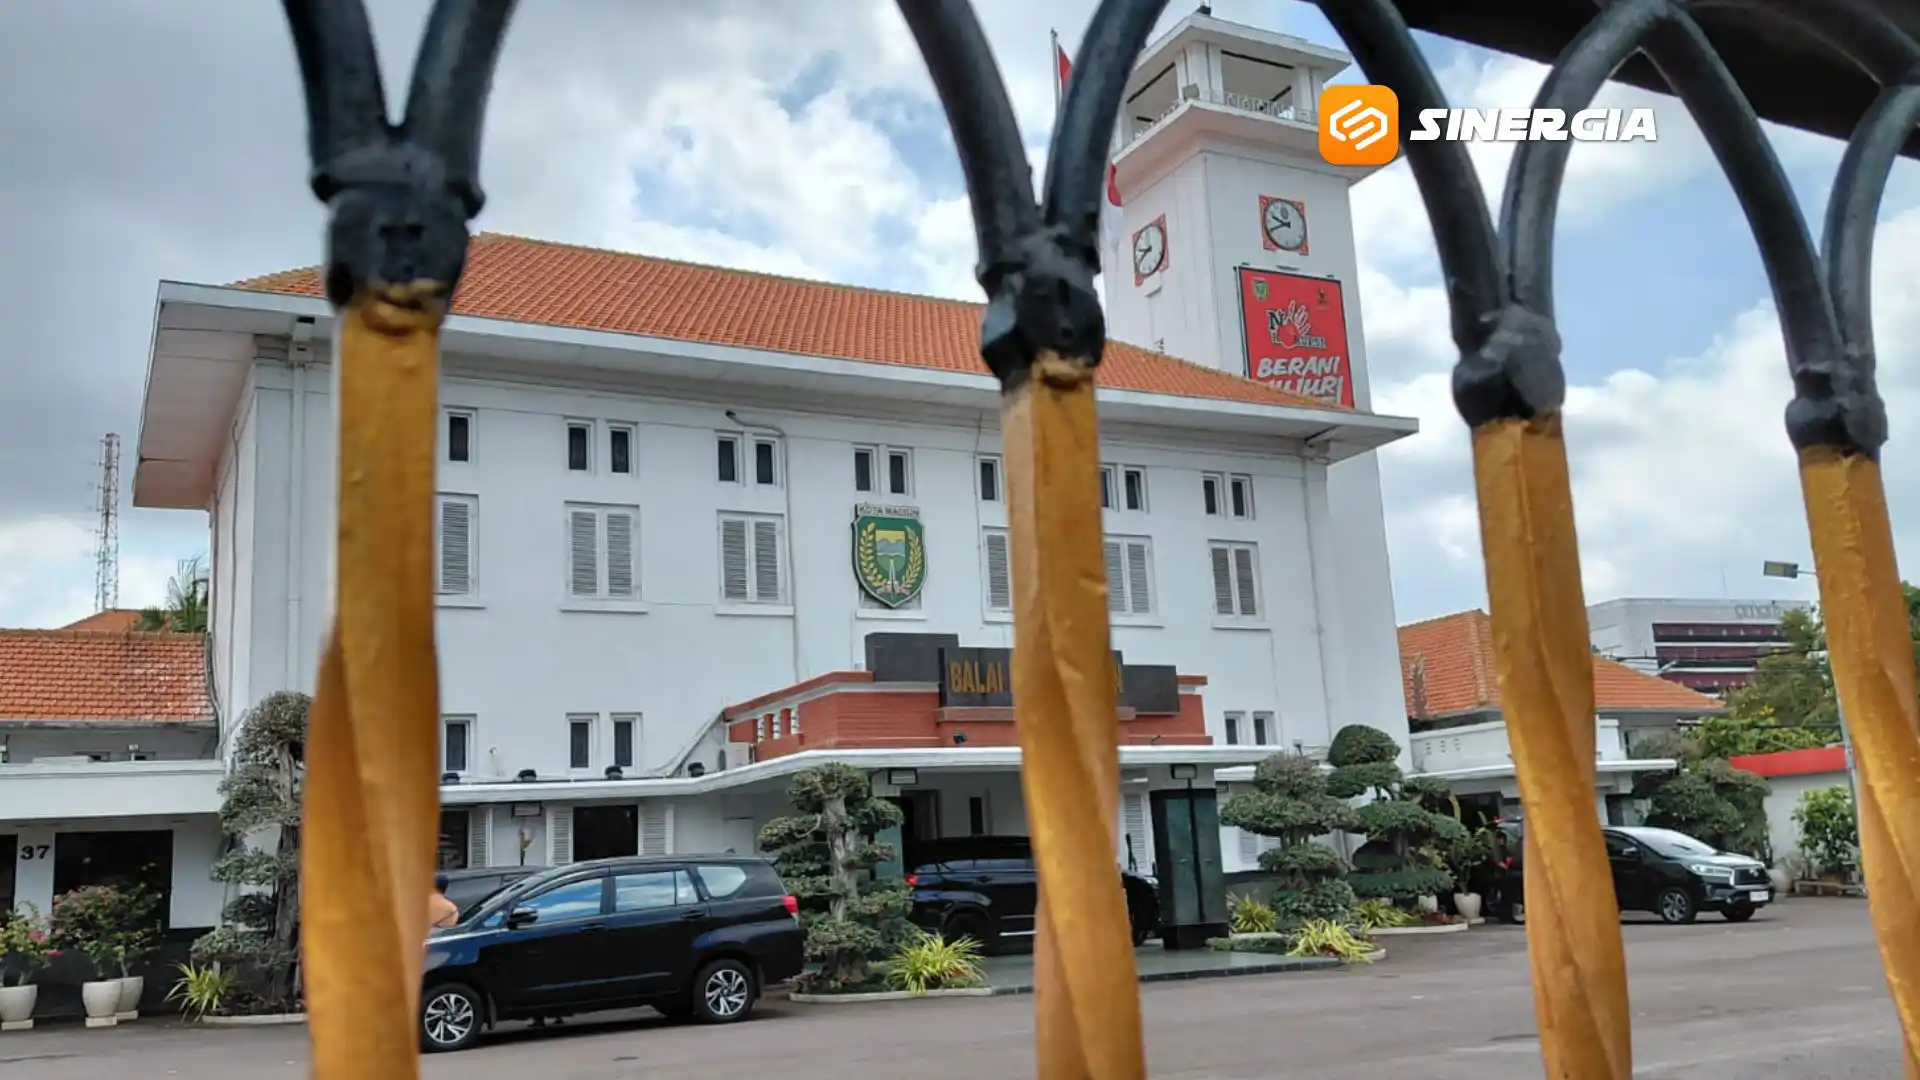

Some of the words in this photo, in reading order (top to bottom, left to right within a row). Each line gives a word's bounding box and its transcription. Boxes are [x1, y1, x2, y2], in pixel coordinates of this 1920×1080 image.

[1257, 356, 1340, 377] BERANI
[951, 660, 1003, 693] BALAI
[20, 845, 50, 860] 37
